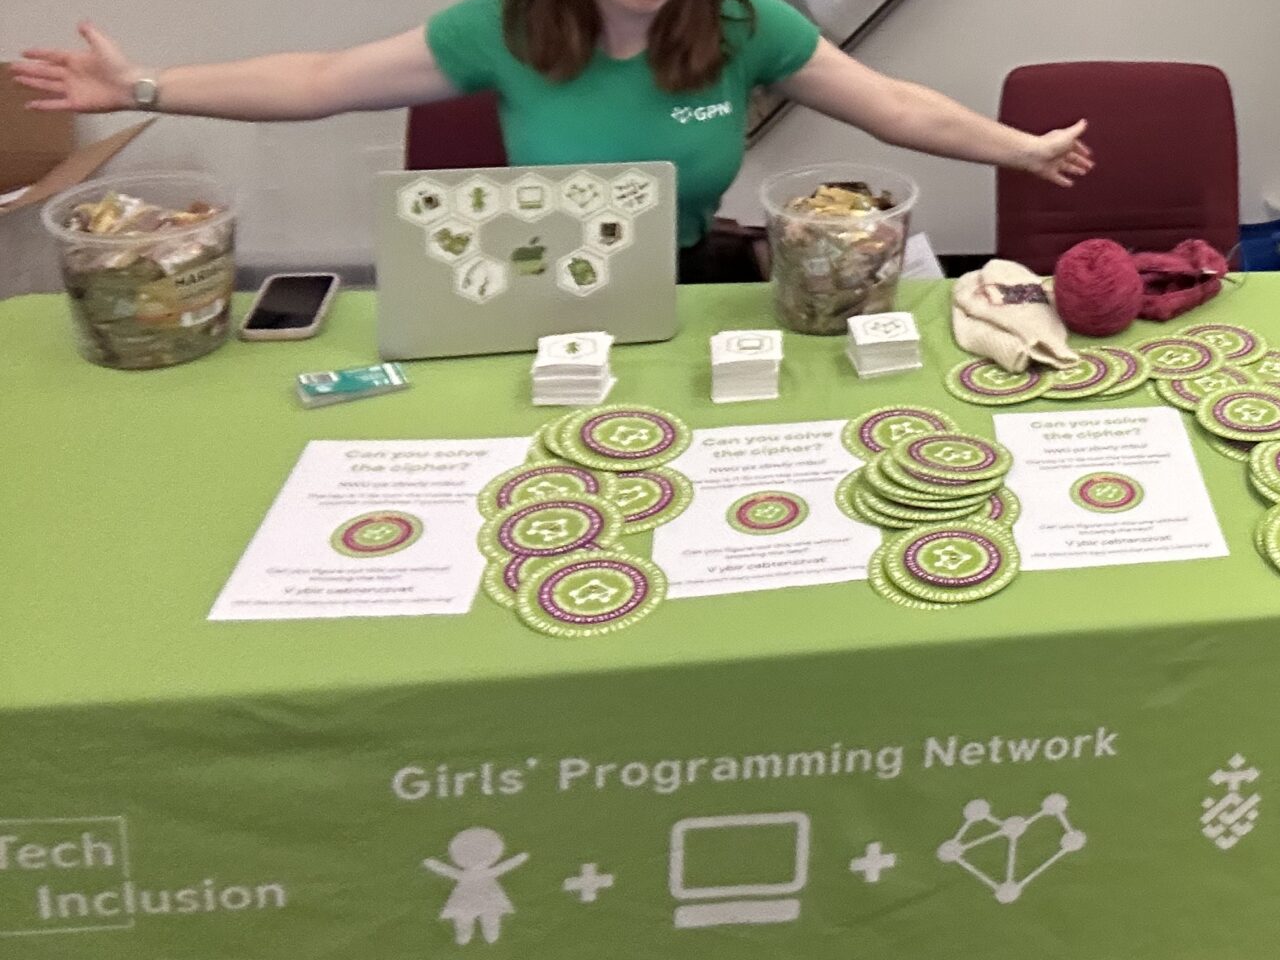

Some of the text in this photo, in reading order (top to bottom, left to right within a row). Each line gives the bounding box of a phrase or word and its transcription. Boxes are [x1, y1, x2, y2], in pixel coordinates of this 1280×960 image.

[702, 430, 834, 447] Can you solve
[712, 447, 751, 458] the
[391, 726, 1119, 801] Girls' Programming Network
[0, 831, 115, 871] Tech
[36, 877, 288, 920] Inclusion
